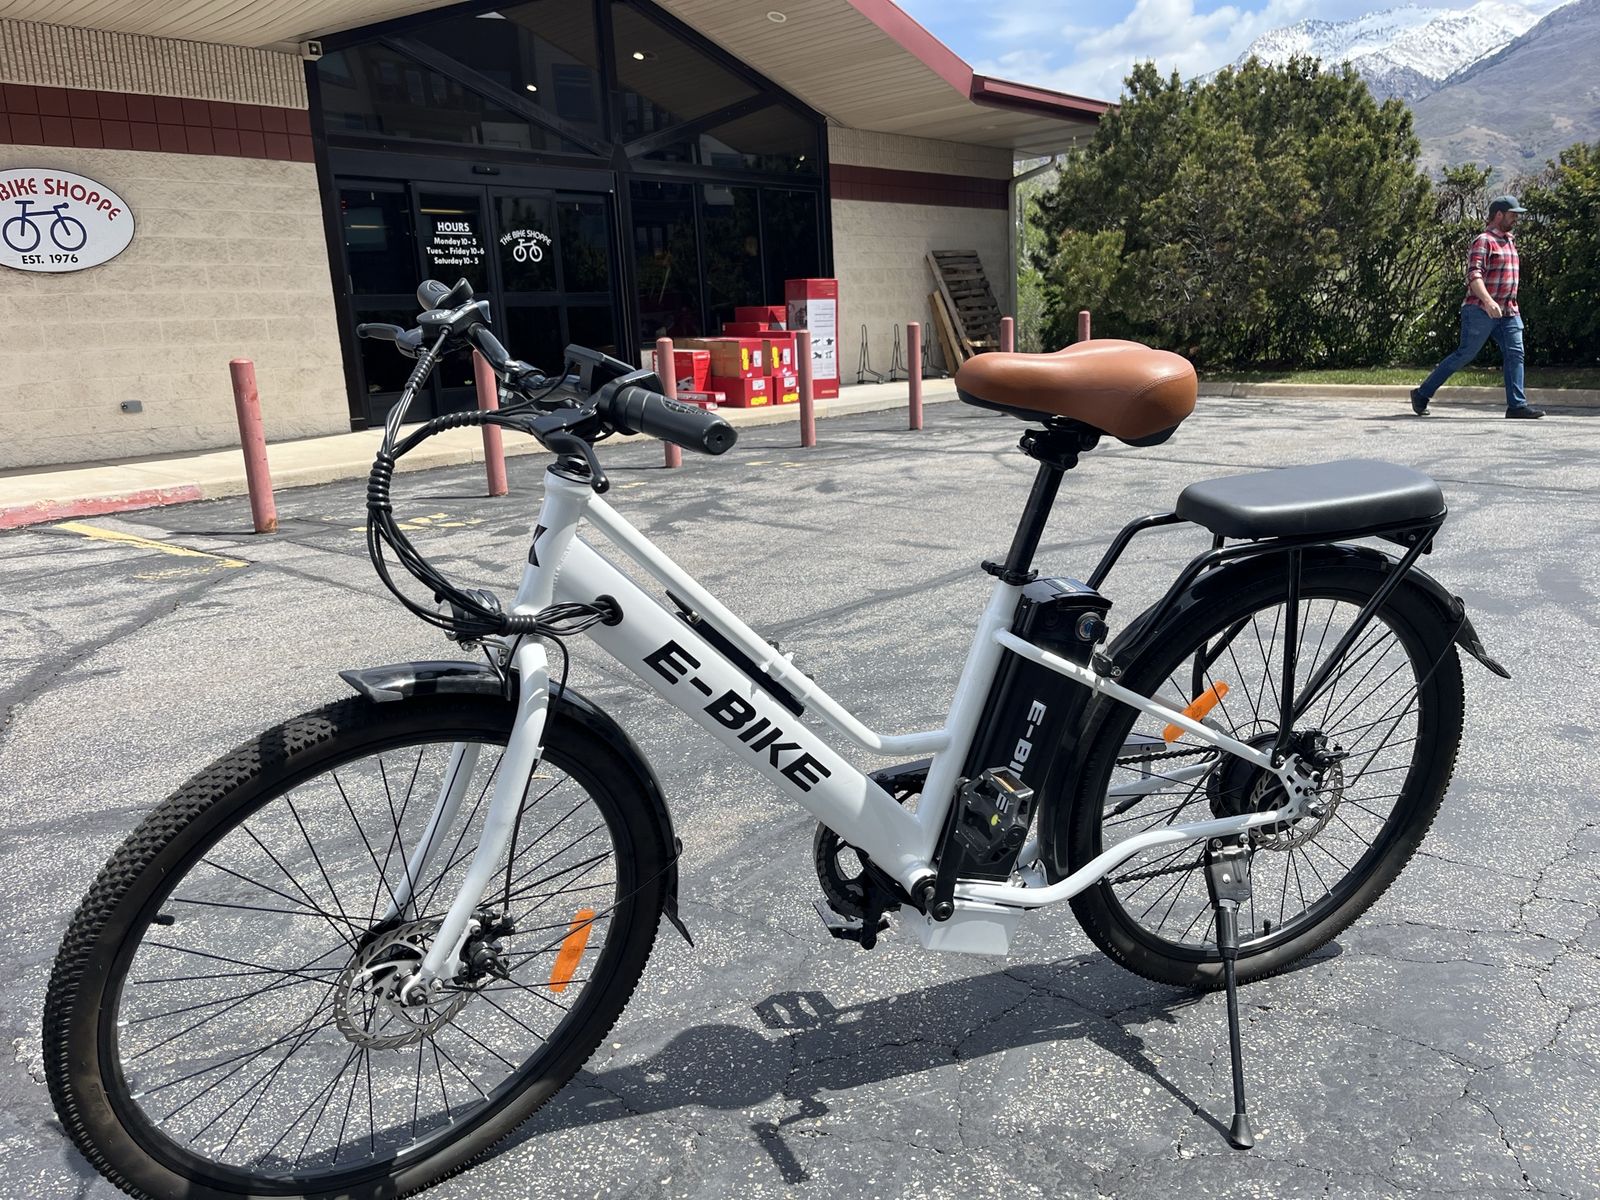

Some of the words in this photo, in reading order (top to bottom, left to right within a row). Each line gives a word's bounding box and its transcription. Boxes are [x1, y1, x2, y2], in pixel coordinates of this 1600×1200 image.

[0, 178, 38, 201] BIKE
[44, 178, 121, 221] SHOPPE
[437, 222, 470, 232] HOURS
[434, 237, 460, 247] Monday
[500, 233, 513, 246] THE
[512, 230, 526, 239] BIKE
[526, 230, 552, 246] SHOPPE
[426, 247, 444, 255] Tues.
[449, 247, 470, 256] Friday
[22, 255, 45, 264] EST.
[49, 254, 79, 264] 1976
[434, 257, 462, 266] Saturday
[642, 639, 832, 793] E-BIKE
